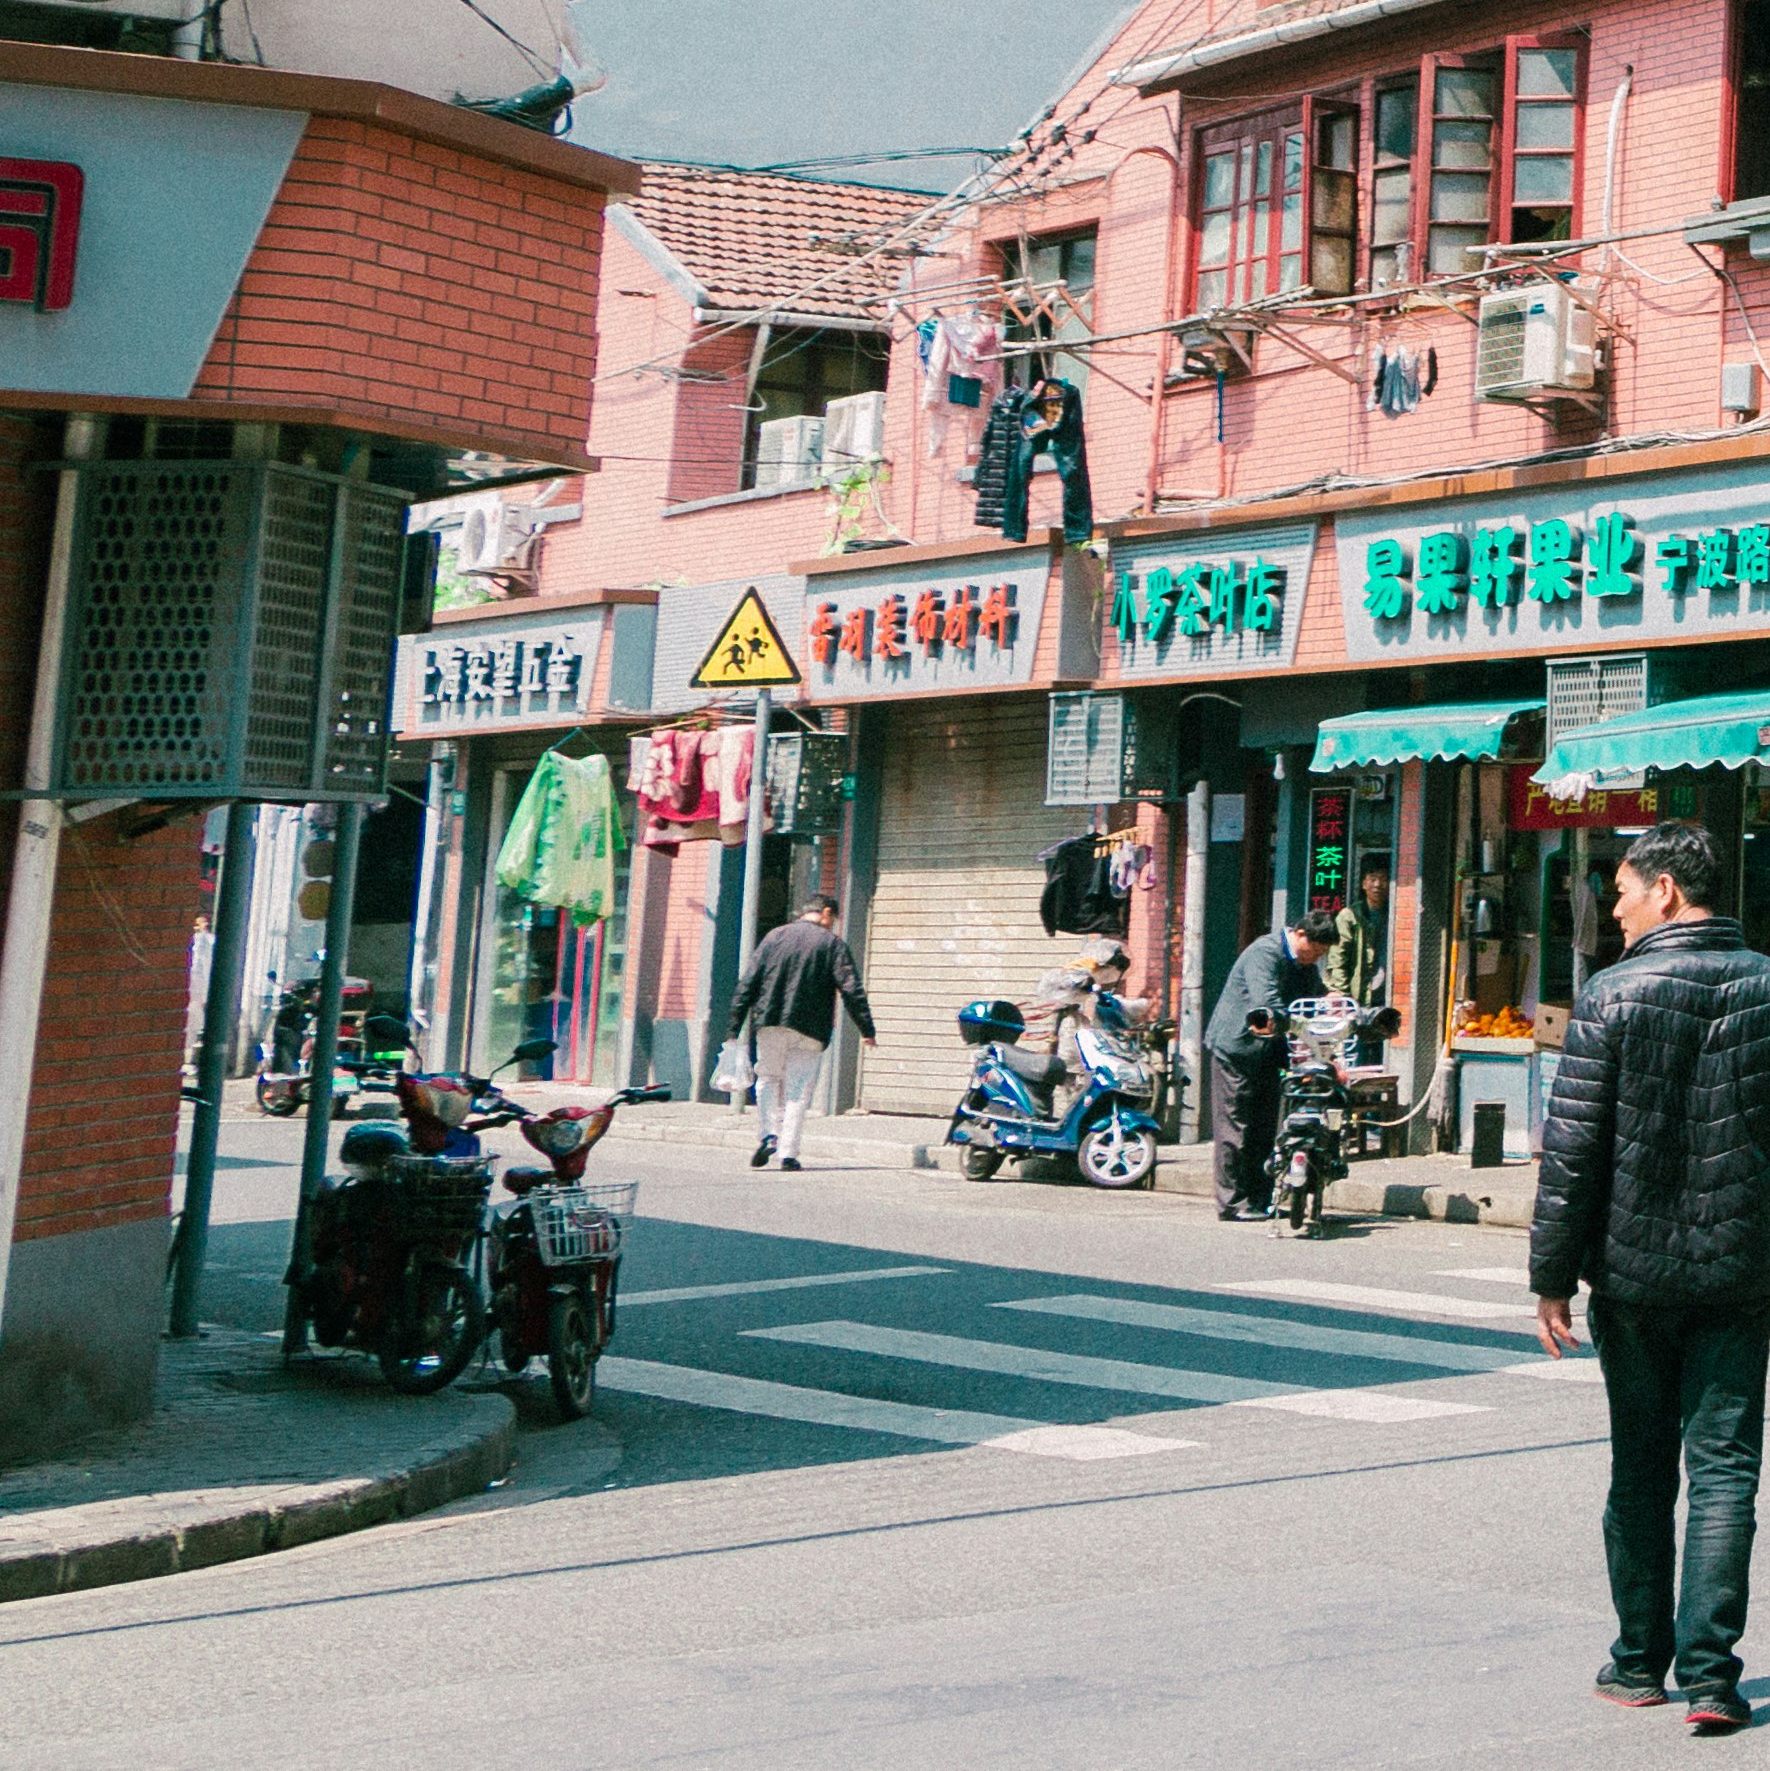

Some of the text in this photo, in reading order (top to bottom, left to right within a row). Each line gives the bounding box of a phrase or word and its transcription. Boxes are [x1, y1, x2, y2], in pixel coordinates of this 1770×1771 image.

[1109, 556, 1274, 642] 小罗茶叶店
[1362, 511, 1634, 619] 易果轩果业
[1312, 895, 1343, 914] TEA
